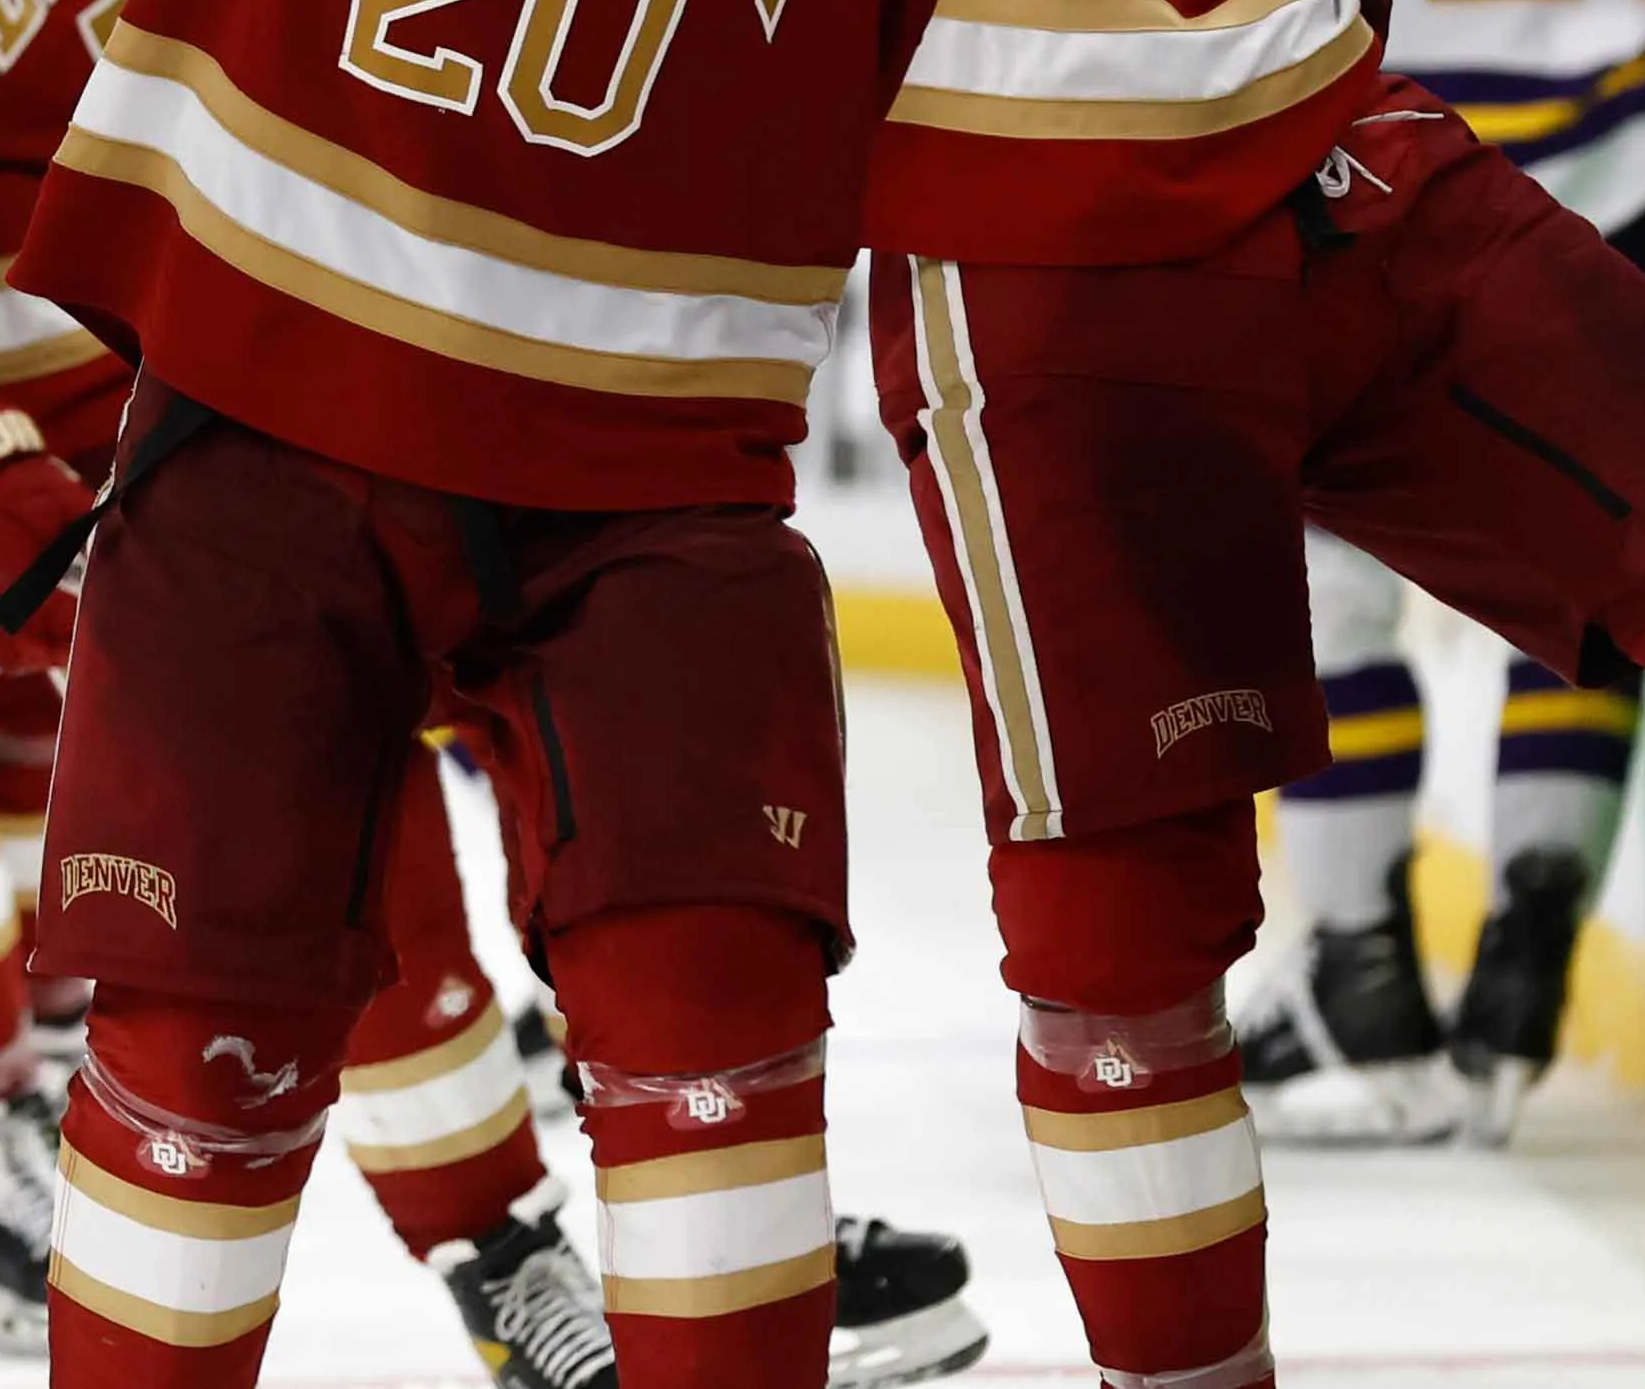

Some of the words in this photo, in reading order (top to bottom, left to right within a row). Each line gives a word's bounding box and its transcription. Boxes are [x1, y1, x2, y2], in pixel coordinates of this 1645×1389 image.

[1150, 688, 1273, 760] DENVER
[60, 852, 178, 931] DENVER
[1094, 1057, 1133, 1088] DU
[687, 1091, 727, 1124] DU
[151, 1141, 187, 1175] DU
